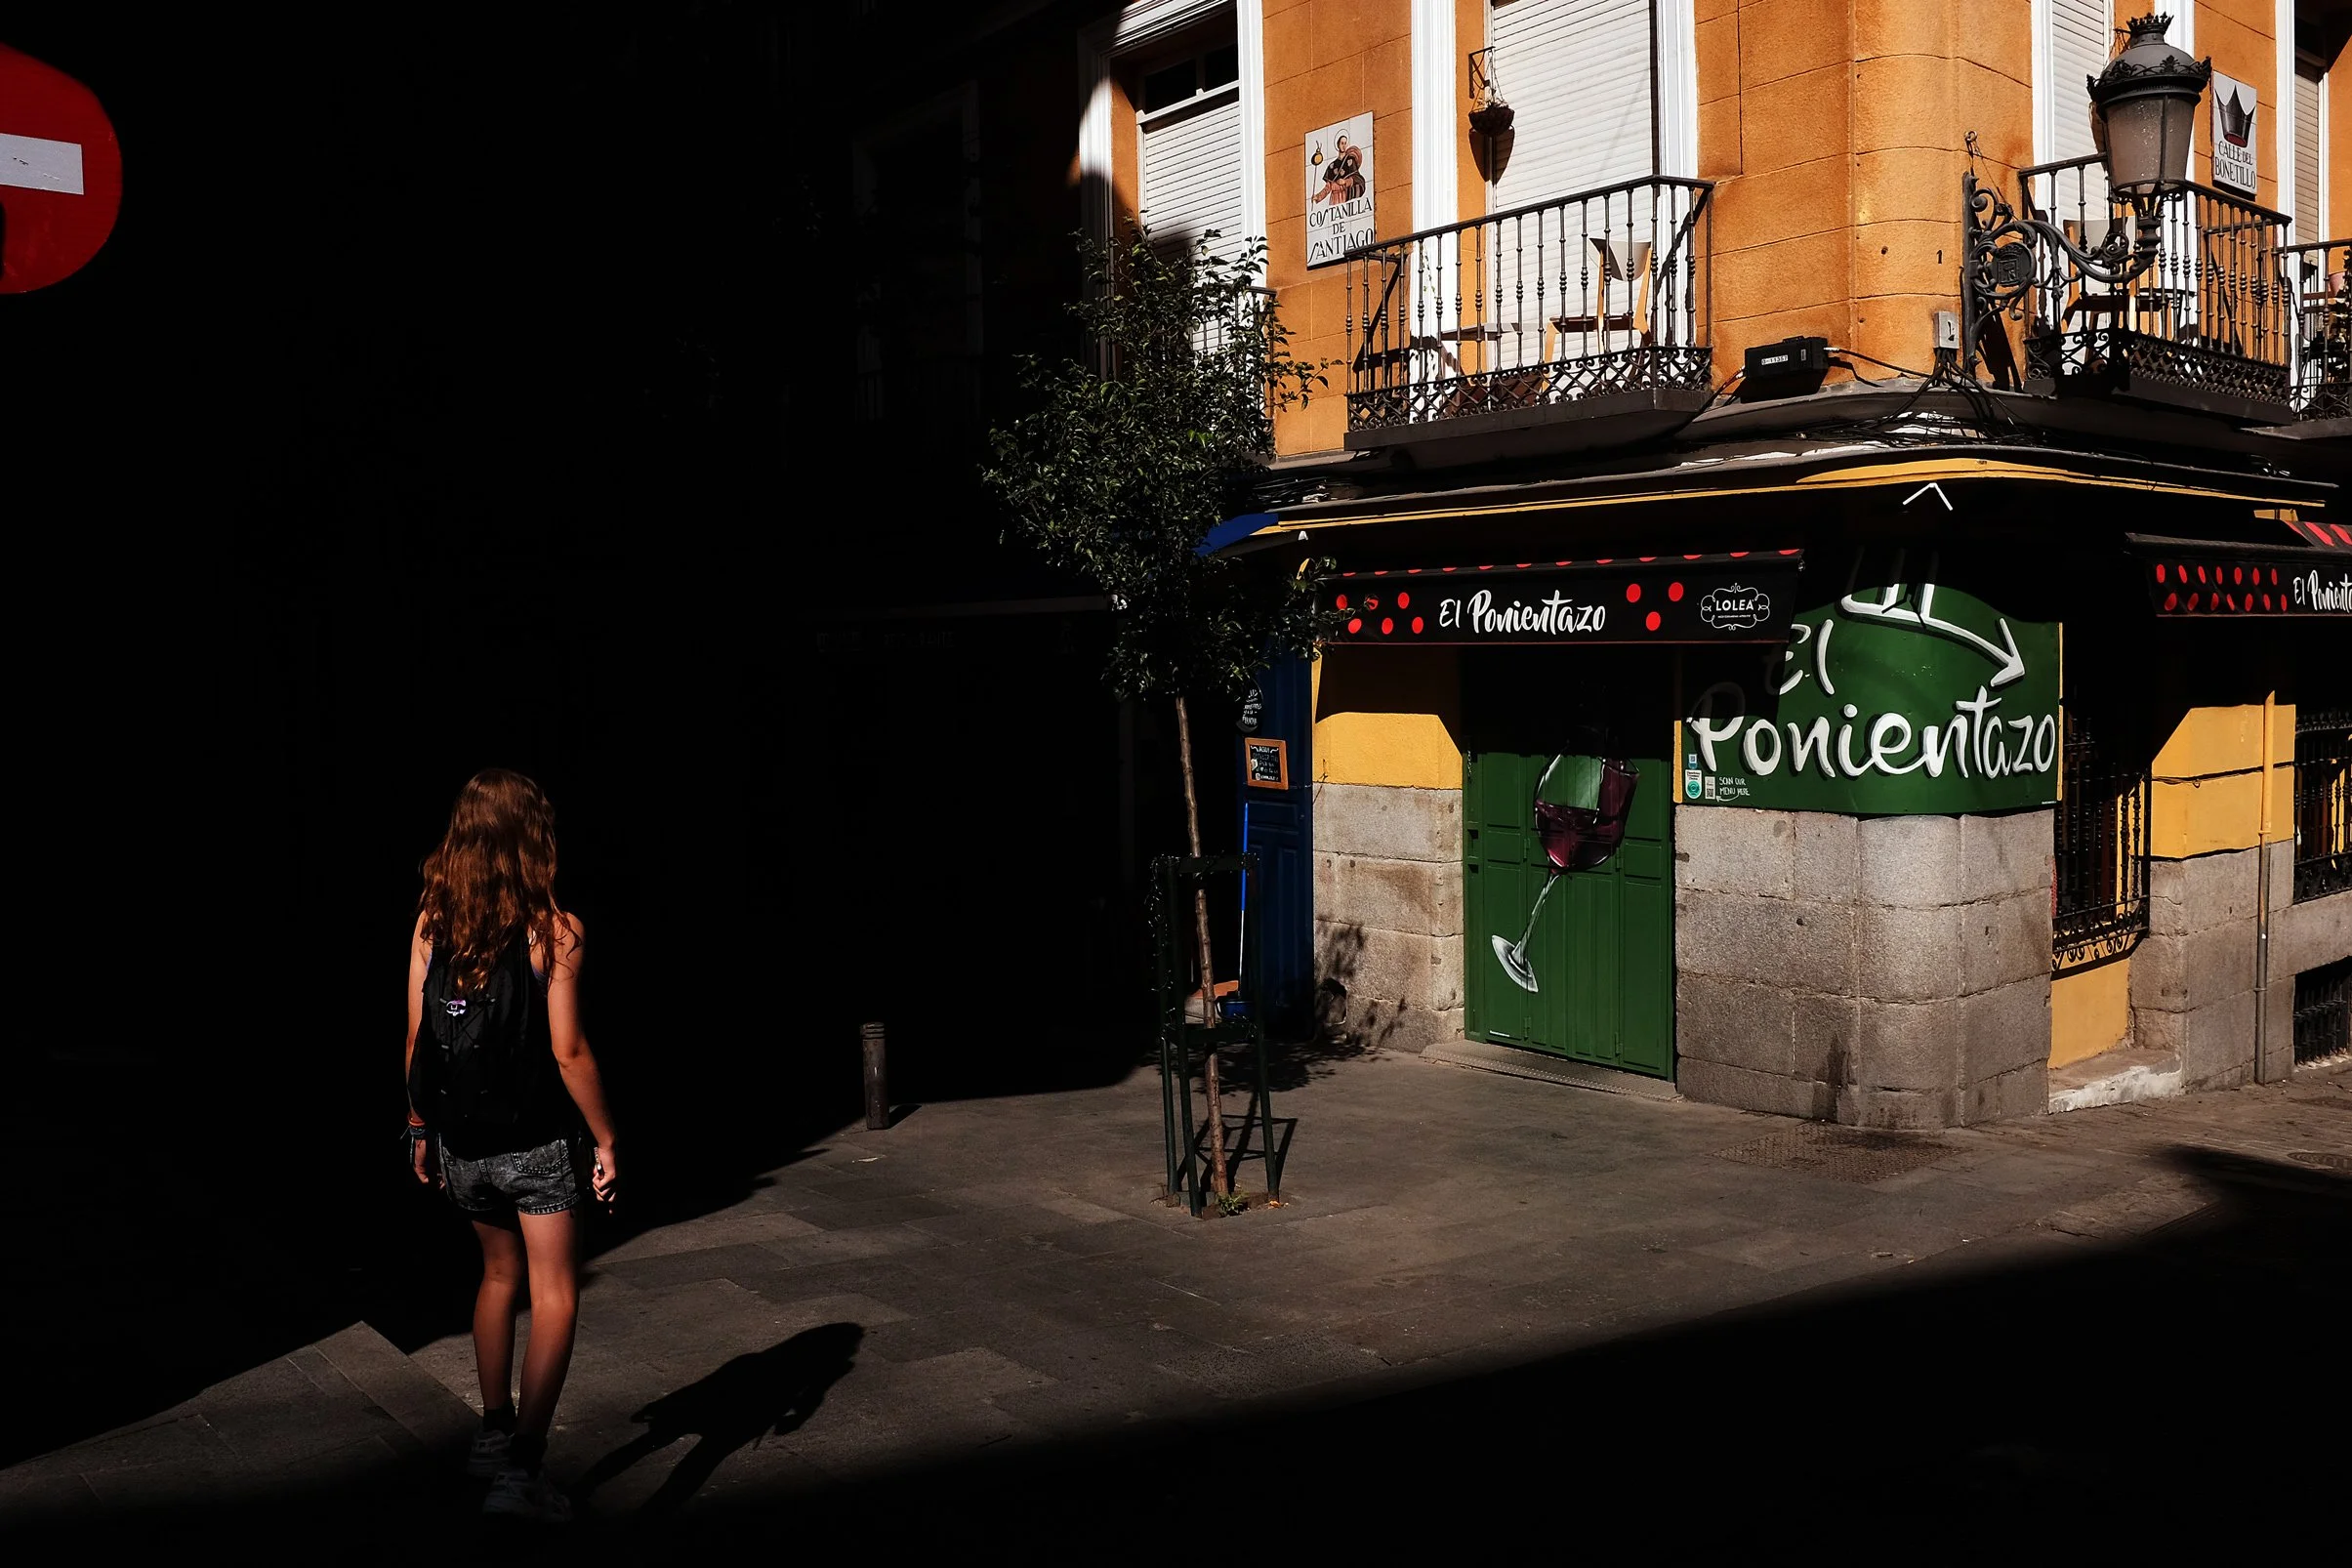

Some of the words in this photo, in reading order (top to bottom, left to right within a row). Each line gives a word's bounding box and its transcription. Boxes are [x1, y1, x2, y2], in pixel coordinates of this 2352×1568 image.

[2218, 141, 2242, 163] CALLE
[2242, 150, 2253, 165] DEL
[2214, 156, 2256, 189] BONETILLO
[1309, 197, 1373, 227] COSTANILLA
[1333, 222, 1345, 235] DE
[1307, 227, 1374, 264] SANTIAGO
[1715, 598, 1754, 611] LOLEA
[2292, 577, 2305, 605] El
[1439, 598, 1461, 629] El
[1466, 589, 1606, 636] Ponientazo
[1685, 681, 2056, 780] Ponientazo
[1718, 776, 1733, 786] SCAN
[1735, 777, 1747, 786] OUR
[1719, 787, 1736, 796] MENU
